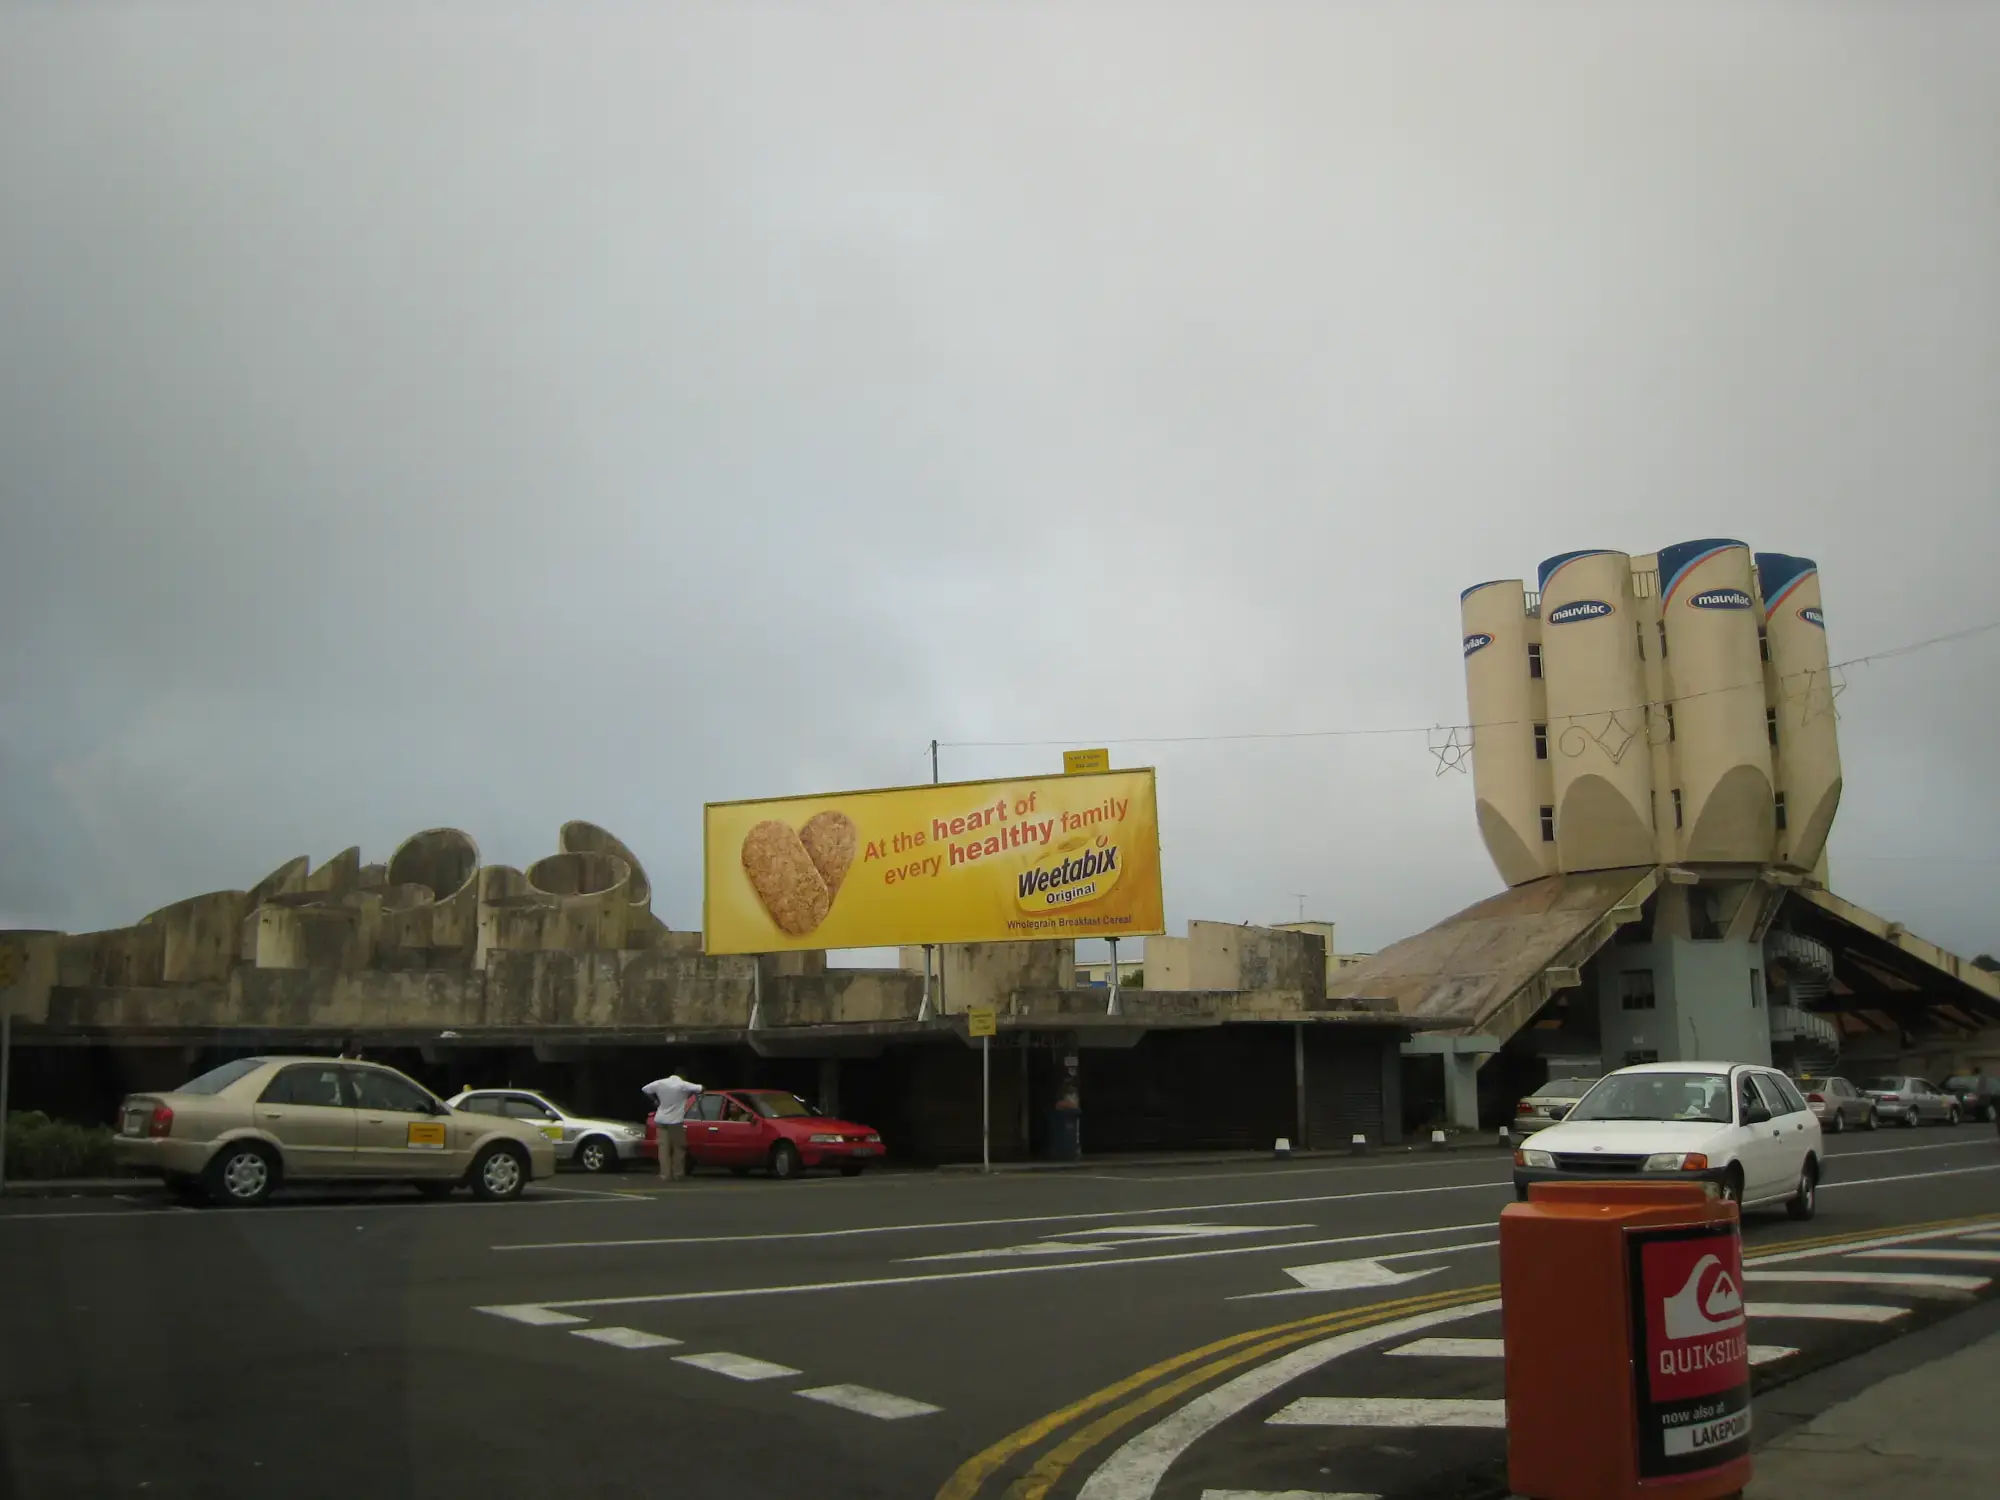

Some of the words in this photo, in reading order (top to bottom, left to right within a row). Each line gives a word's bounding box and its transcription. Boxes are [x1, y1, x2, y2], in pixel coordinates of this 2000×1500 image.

[1698, 593, 1750, 606] mauvilac
[1552, 604, 1605, 621] mauvilac
[864, 837, 887, 862] At
[892, 831, 925, 853] the
[932, 799, 1007, 841] heart
[1015, 791, 1036, 815] of
[885, 855, 942, 884] every
[949, 819, 1054, 866] healthy
[1061, 798, 1128, 832] family
[1018, 838, 1117, 898] Weetabix
[1046, 882, 1095, 903] Original
[1008, 918, 1056, 930] Wholegrain
[1059, 916, 1100, 927] Breakfast
[1103, 914, 1132, 925] Cereal
[1662, 1411, 1690, 1424] now
[1693, 1404, 1715, 1419] also
